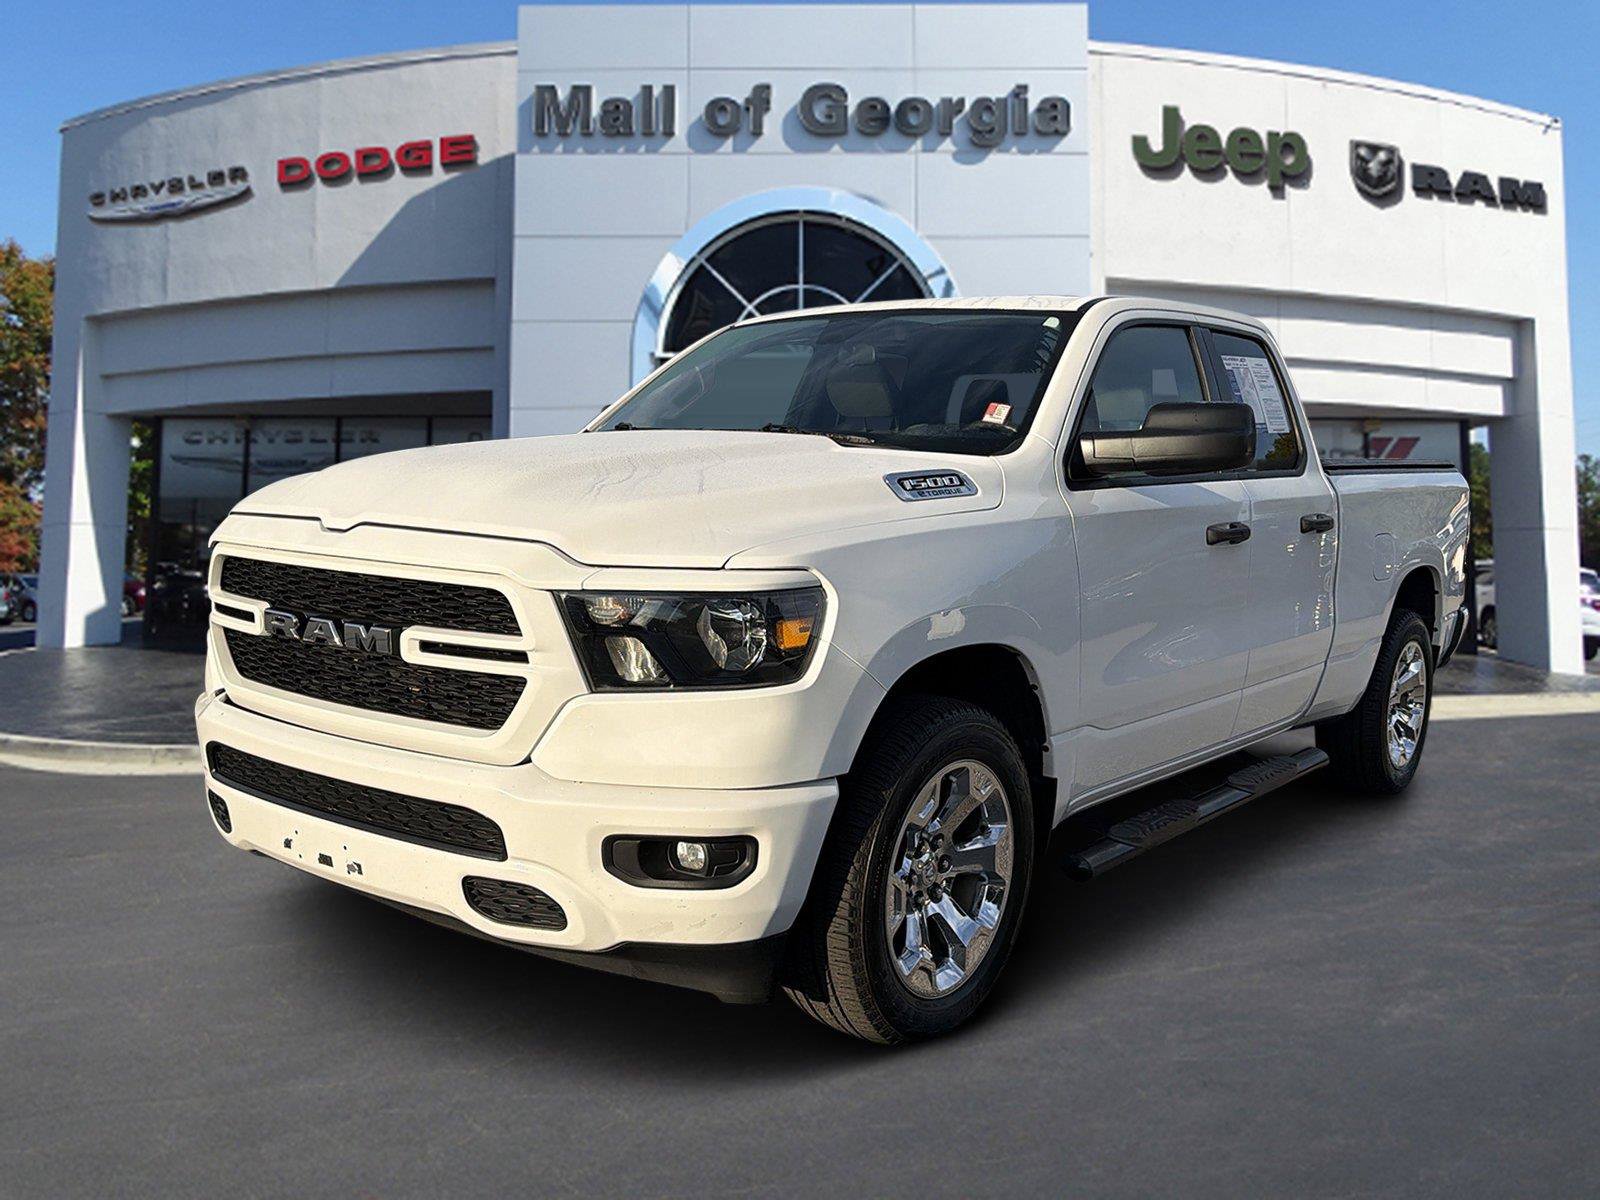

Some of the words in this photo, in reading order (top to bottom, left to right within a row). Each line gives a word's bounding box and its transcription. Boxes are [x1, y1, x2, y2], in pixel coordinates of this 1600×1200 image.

[533, 85, 676, 137] Mall
[704, 83, 772, 136] of
[800, 83, 1072, 148] Georgia
[277, 134, 477, 187] DODGE
[1132, 105, 1309, 188] Jeep
[89, 165, 249, 206] CHRYSLER
[1411, 163, 1548, 211] RAM
[901, 475, 961, 490] 1500
[263, 608, 393, 655] RAM
